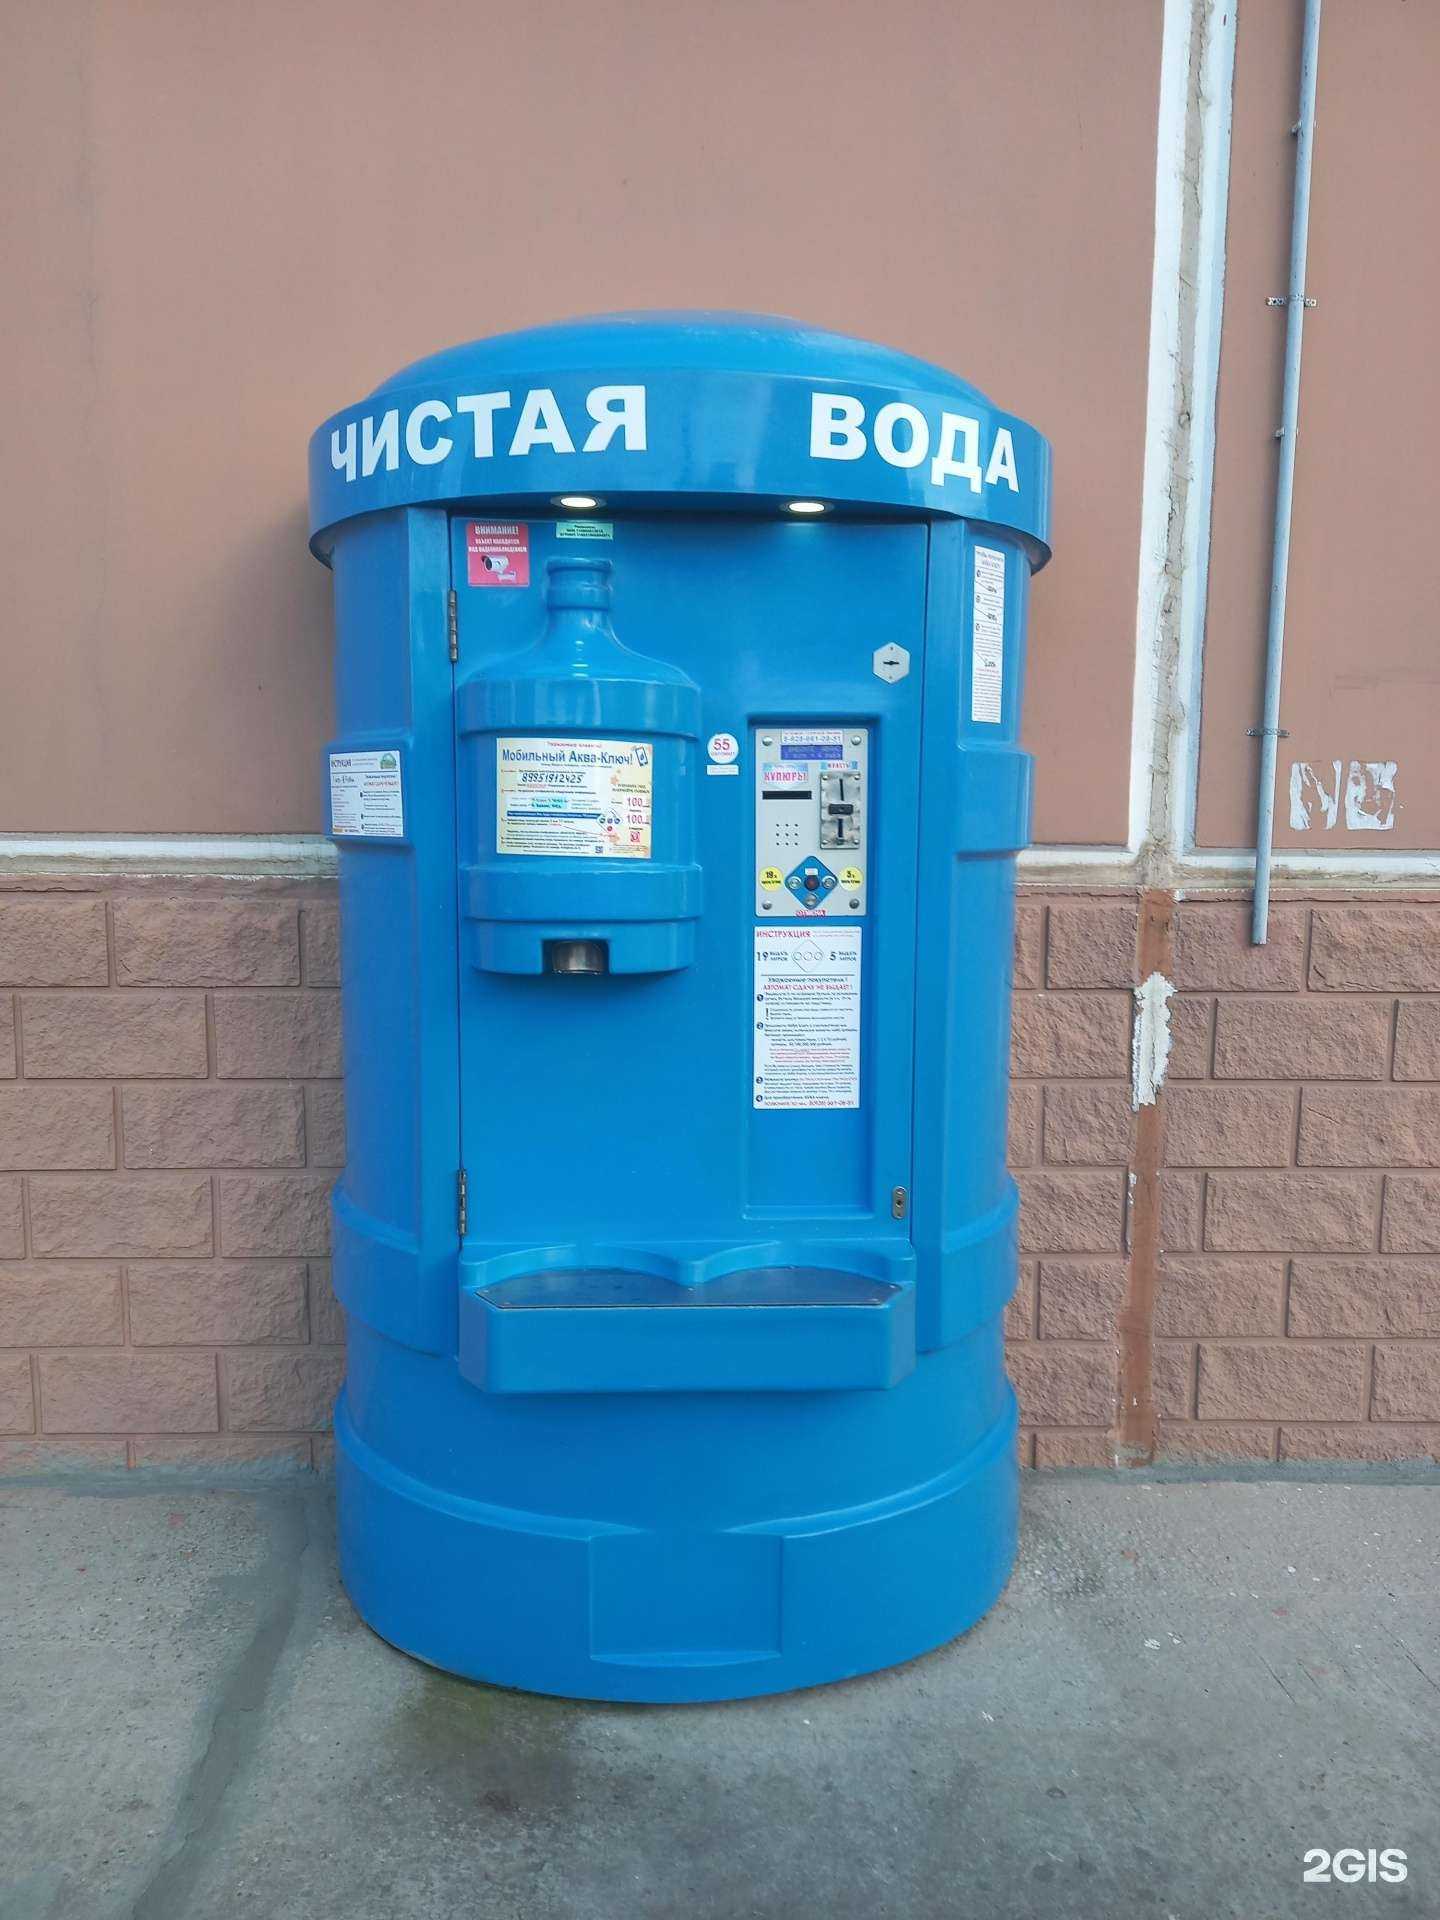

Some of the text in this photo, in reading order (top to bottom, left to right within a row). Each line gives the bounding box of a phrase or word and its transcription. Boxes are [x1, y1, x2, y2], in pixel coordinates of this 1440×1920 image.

[331, 385, 1019, 494] ЧИСТАЯ ВОДА
[713, 738, 730, 751] 55
[502, 749, 633, 765] Мобильный Аква-Ключ!
[764, 771, 807, 781] КУПЮРЫ
[757, 930, 811, 938] ИНСТРУКЦИЯ
[756, 951, 769, 961] 19
[829, 951, 838, 961] 5
